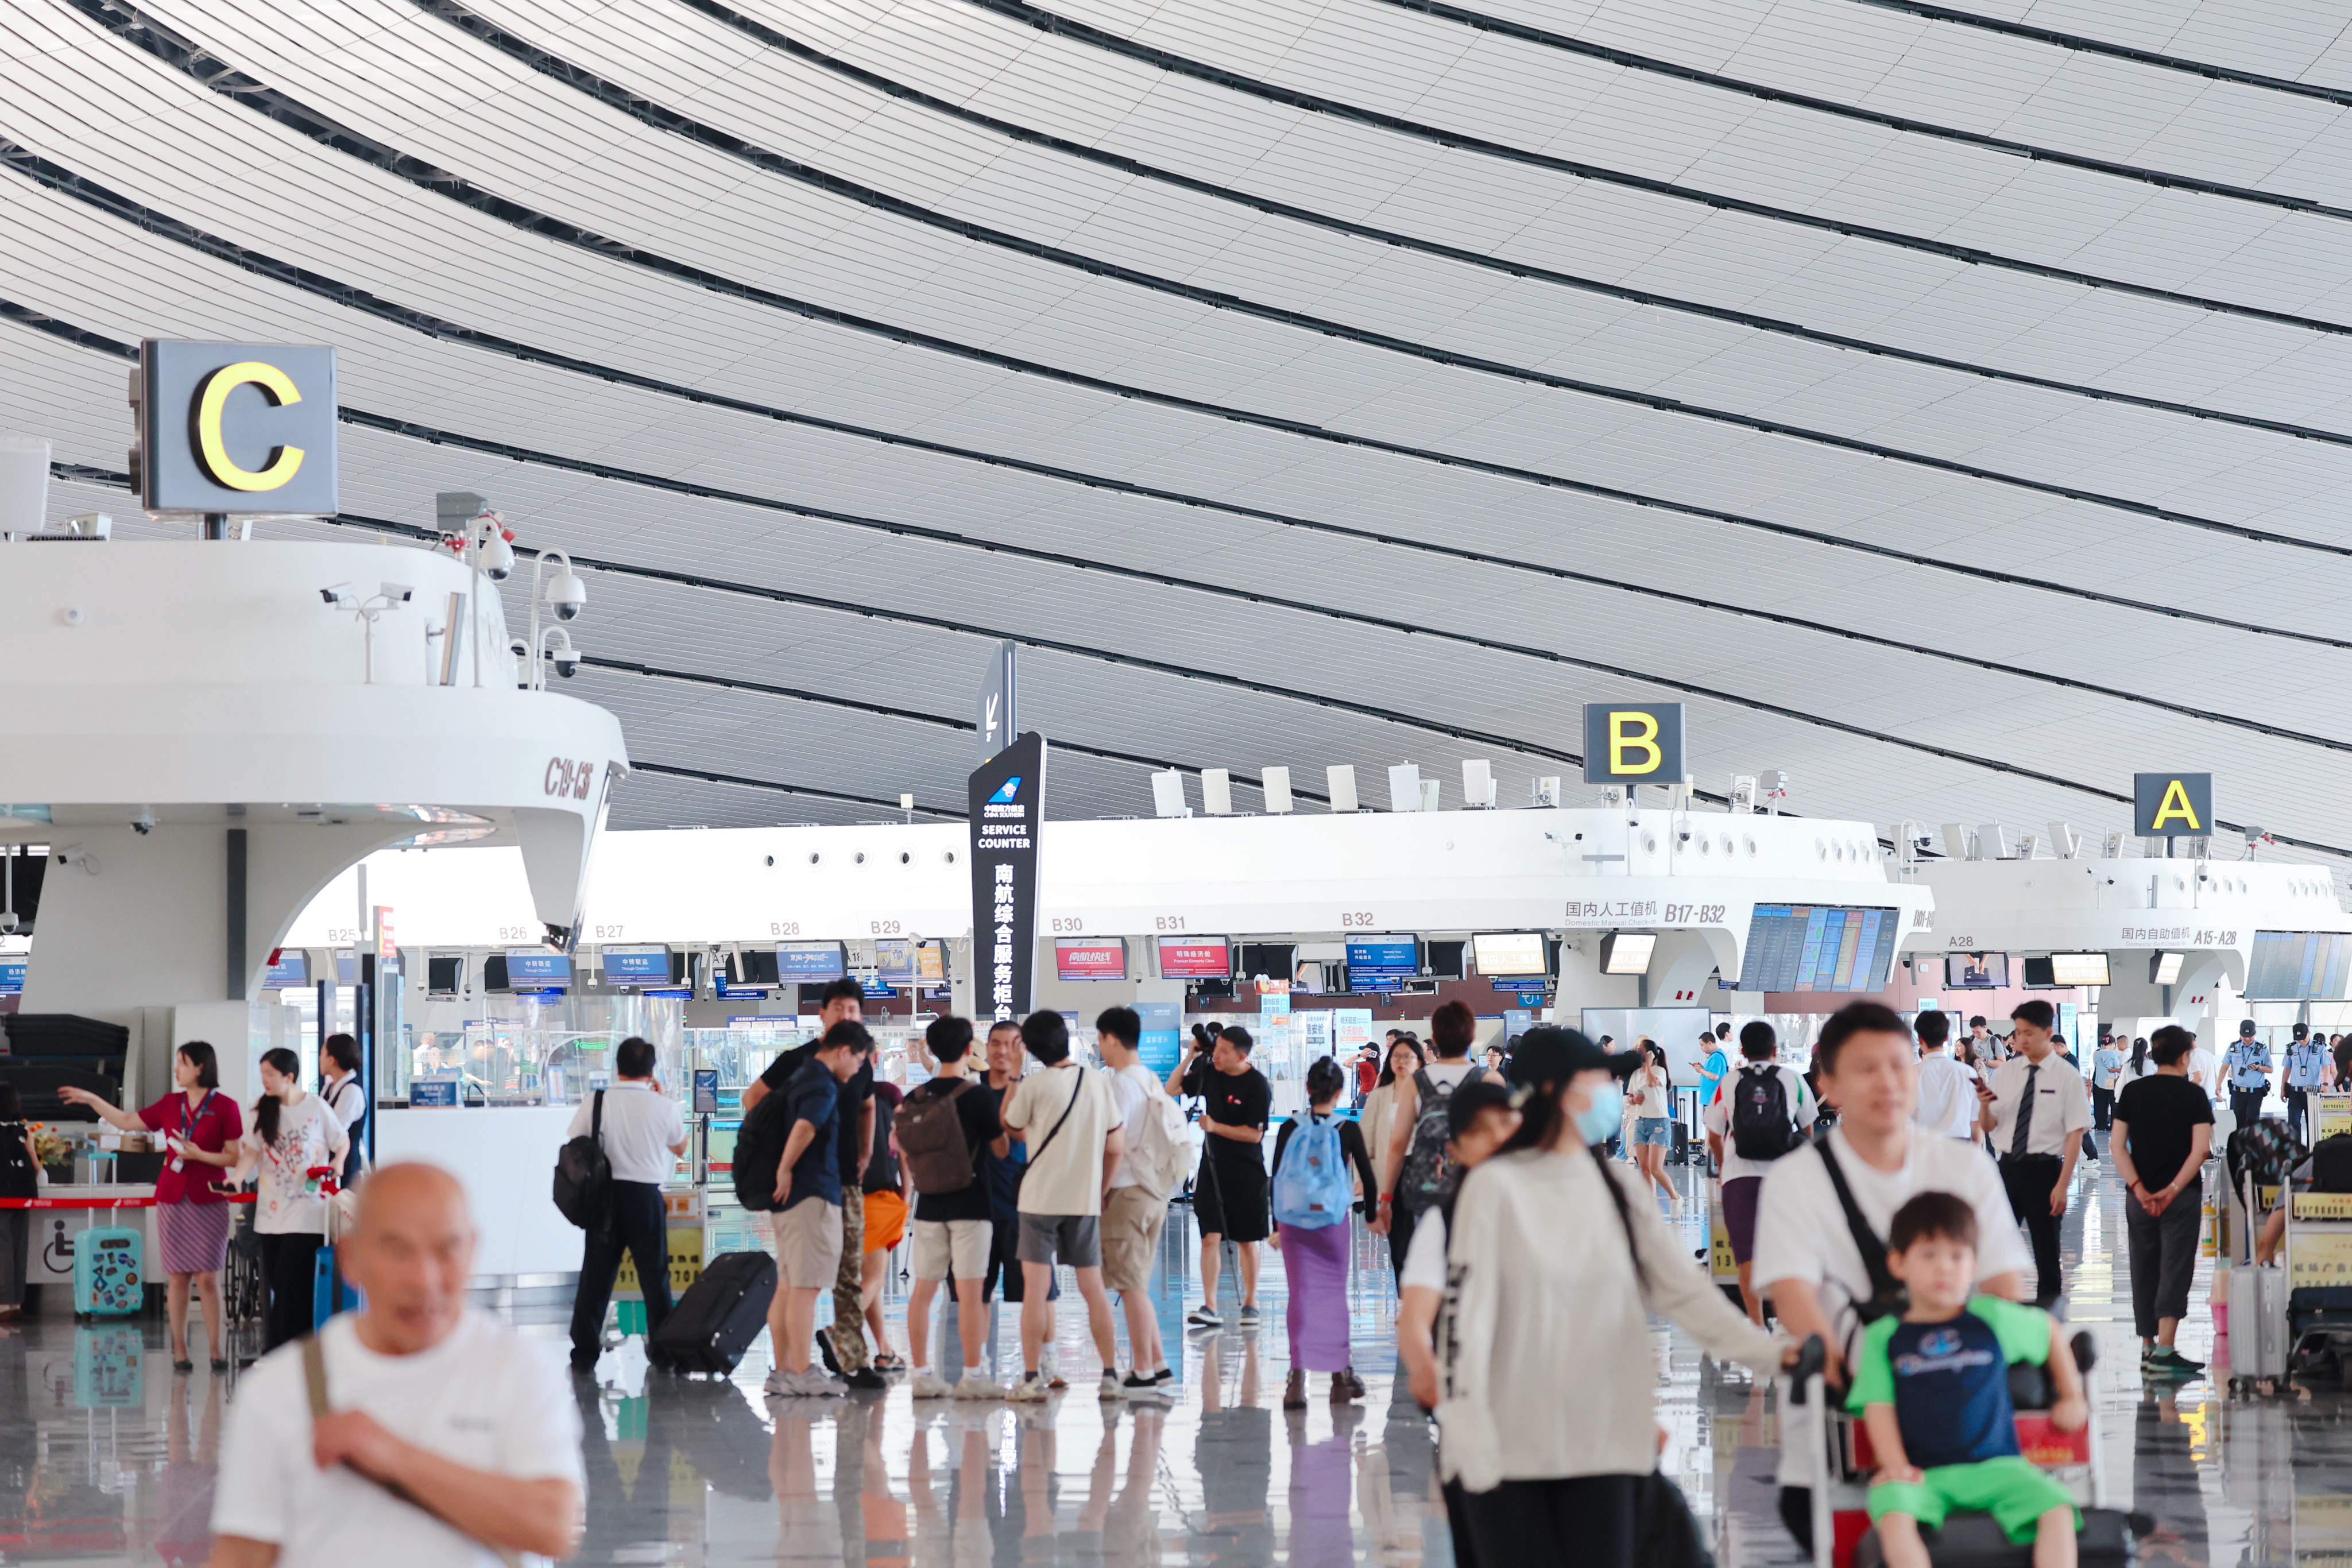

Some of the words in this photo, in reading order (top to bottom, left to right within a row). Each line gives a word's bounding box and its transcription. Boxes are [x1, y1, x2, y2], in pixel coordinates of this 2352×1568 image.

[200, 361, 304, 491] C
[1610, 711, 1662, 774] B
[2152, 780, 2200, 829] A
[981, 824, 1027, 835] SERVICE
[978, 838, 1030, 849] COUNTER
[1566, 901, 1657, 917] 国内人工值机
[1665, 904, 1726, 923] B17-B32
[1052, 917, 1082, 931] B30
[1156, 916, 1185, 930] B31
[1342, 912, 1374, 926] B32
[500, 927, 527, 939] B26
[595, 926, 624, 938] B27
[771, 922, 800, 935] B28
[871, 920, 900, 934] B29
[2122, 927, 2190, 940] 国内自助值机
[328, 929, 356, 941] B25
[1949, 936, 1974, 947] A28
[2194, 930, 2237, 945] A15-A28
[993, 864, 1014, 1023] 南航综合服务柜台
[1069, 951, 1111, 962] 南航快线
[1478, 953, 1541, 965] 国内人工值机
[2055, 969, 2106, 977] 国内自助值机
[1341, 1025, 1364, 1036] 今天能办
